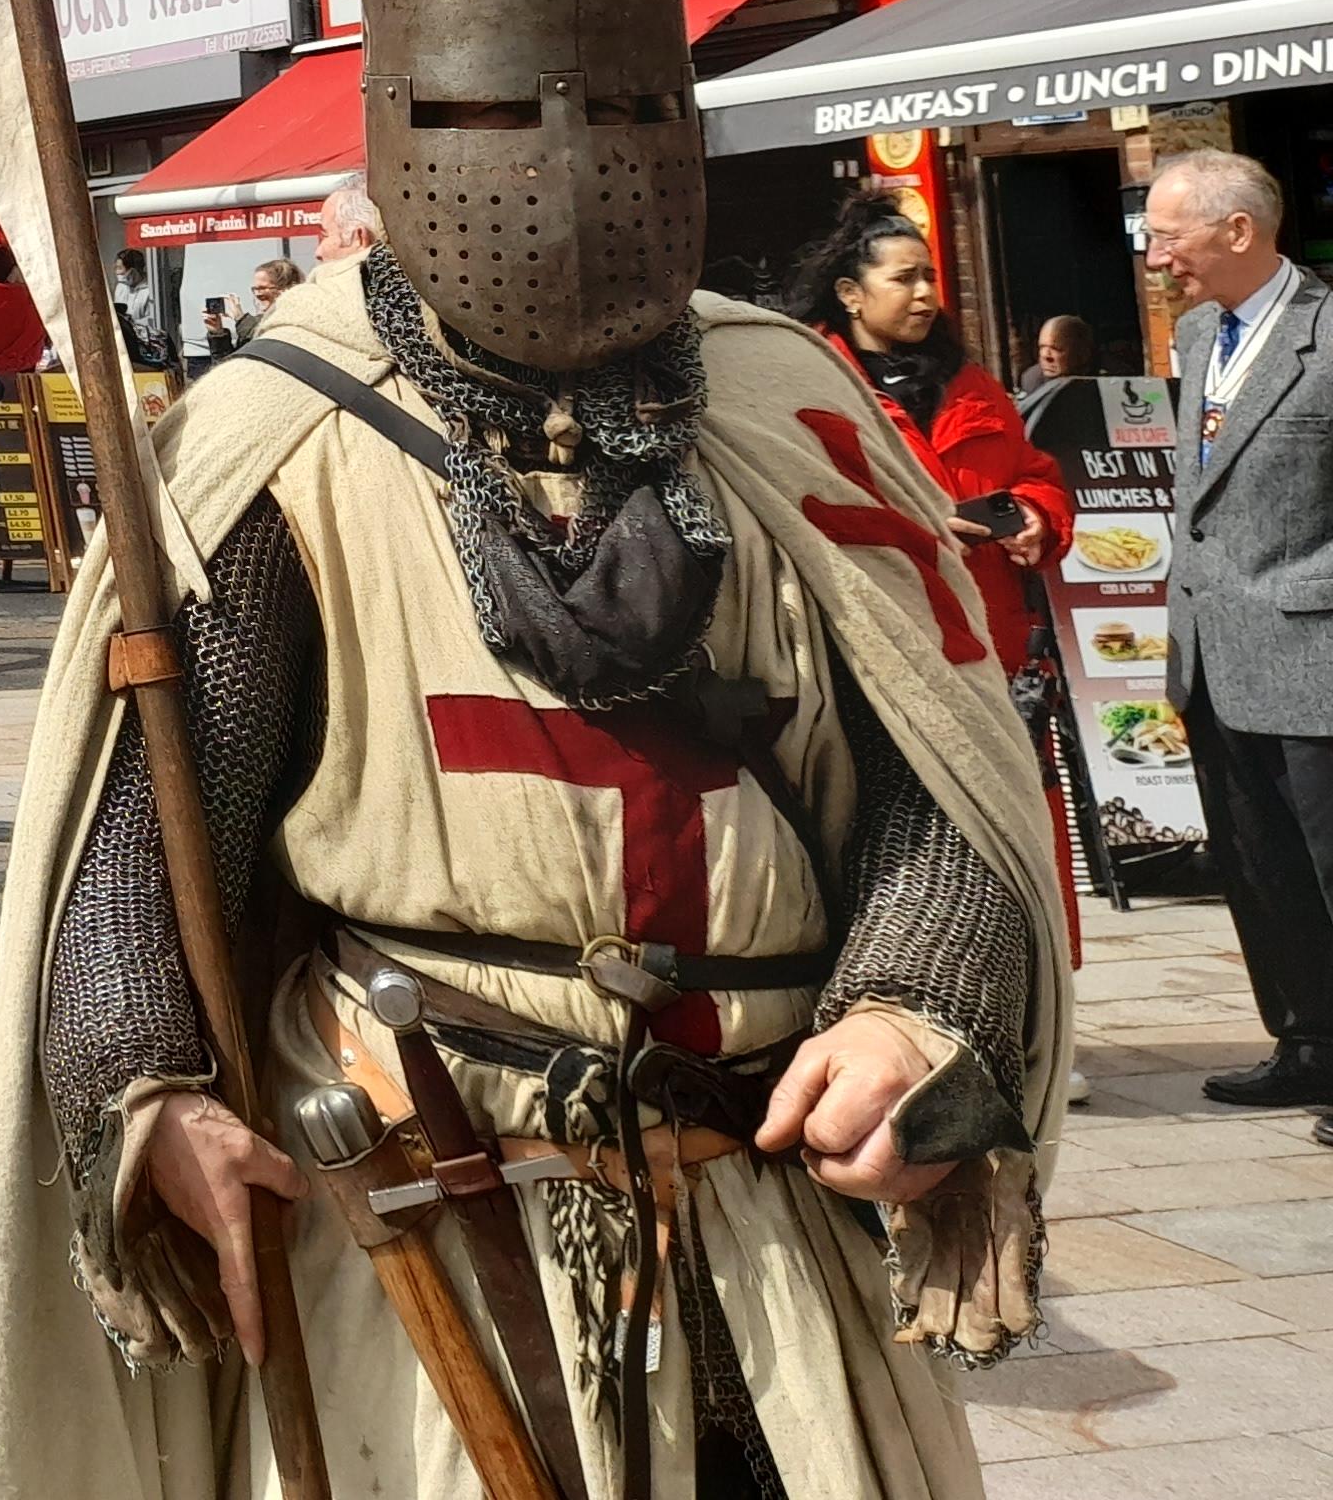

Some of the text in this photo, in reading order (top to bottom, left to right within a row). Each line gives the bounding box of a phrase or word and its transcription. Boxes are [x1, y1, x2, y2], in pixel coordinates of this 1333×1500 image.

[815, 83, 997, 135] BREAKFAST
[1035, 60, 1167, 106] LUNCH
[140, 219, 197, 238] Sandwich
[206, 213, 247, 232] Panini
[256, 209, 282, 228] Roll
[1082, 449, 1176, 478] BEST IN T
[1075, 488, 1171, 508] LUNCHES &
